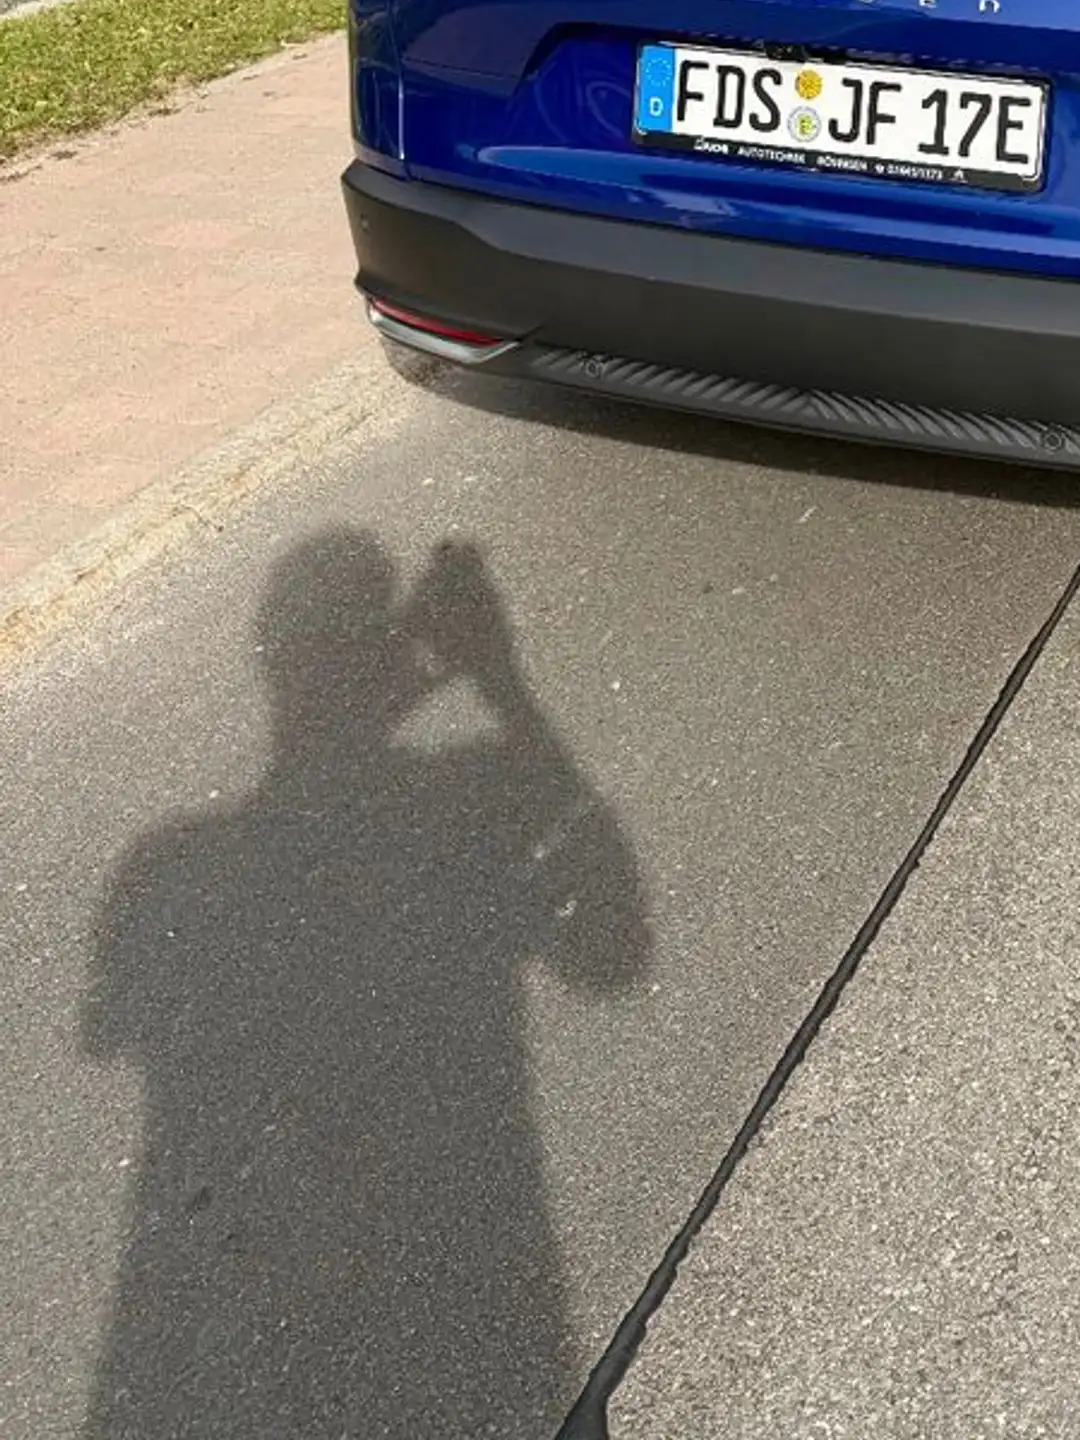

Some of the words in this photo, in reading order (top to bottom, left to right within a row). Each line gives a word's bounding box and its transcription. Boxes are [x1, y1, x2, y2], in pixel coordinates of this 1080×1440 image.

[648, 97, 663, 116] D
[675, 59, 783, 133] FDS
[828, 78, 902, 145] JF
[917, 89, 1033, 164] 17E
